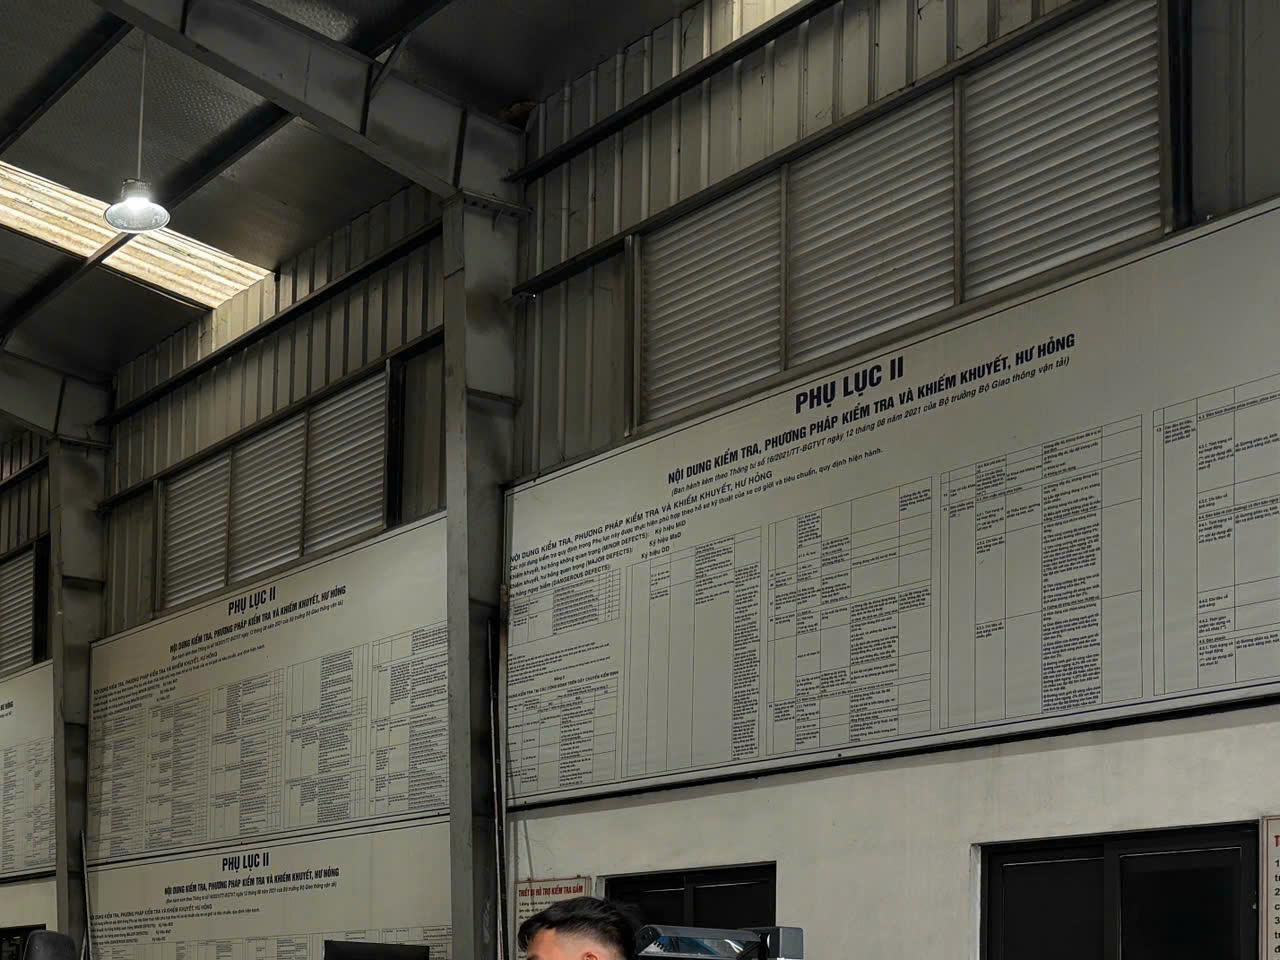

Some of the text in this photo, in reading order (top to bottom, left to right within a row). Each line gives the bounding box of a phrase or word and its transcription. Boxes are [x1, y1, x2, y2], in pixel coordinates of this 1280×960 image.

[795, 356, 904, 414] PHỤ LỤC II
[668, 333, 1075, 484] NỘI DUNG KIỂM TRA, PHƯƠNG PHÁP KIỂM TRA VÀ KHIẾM KHUYẾT, HƯ HỎNG
[228, 586, 276, 616] PHỤ LỤC II
[222, 852, 270, 872] PHỤ LỤC II
